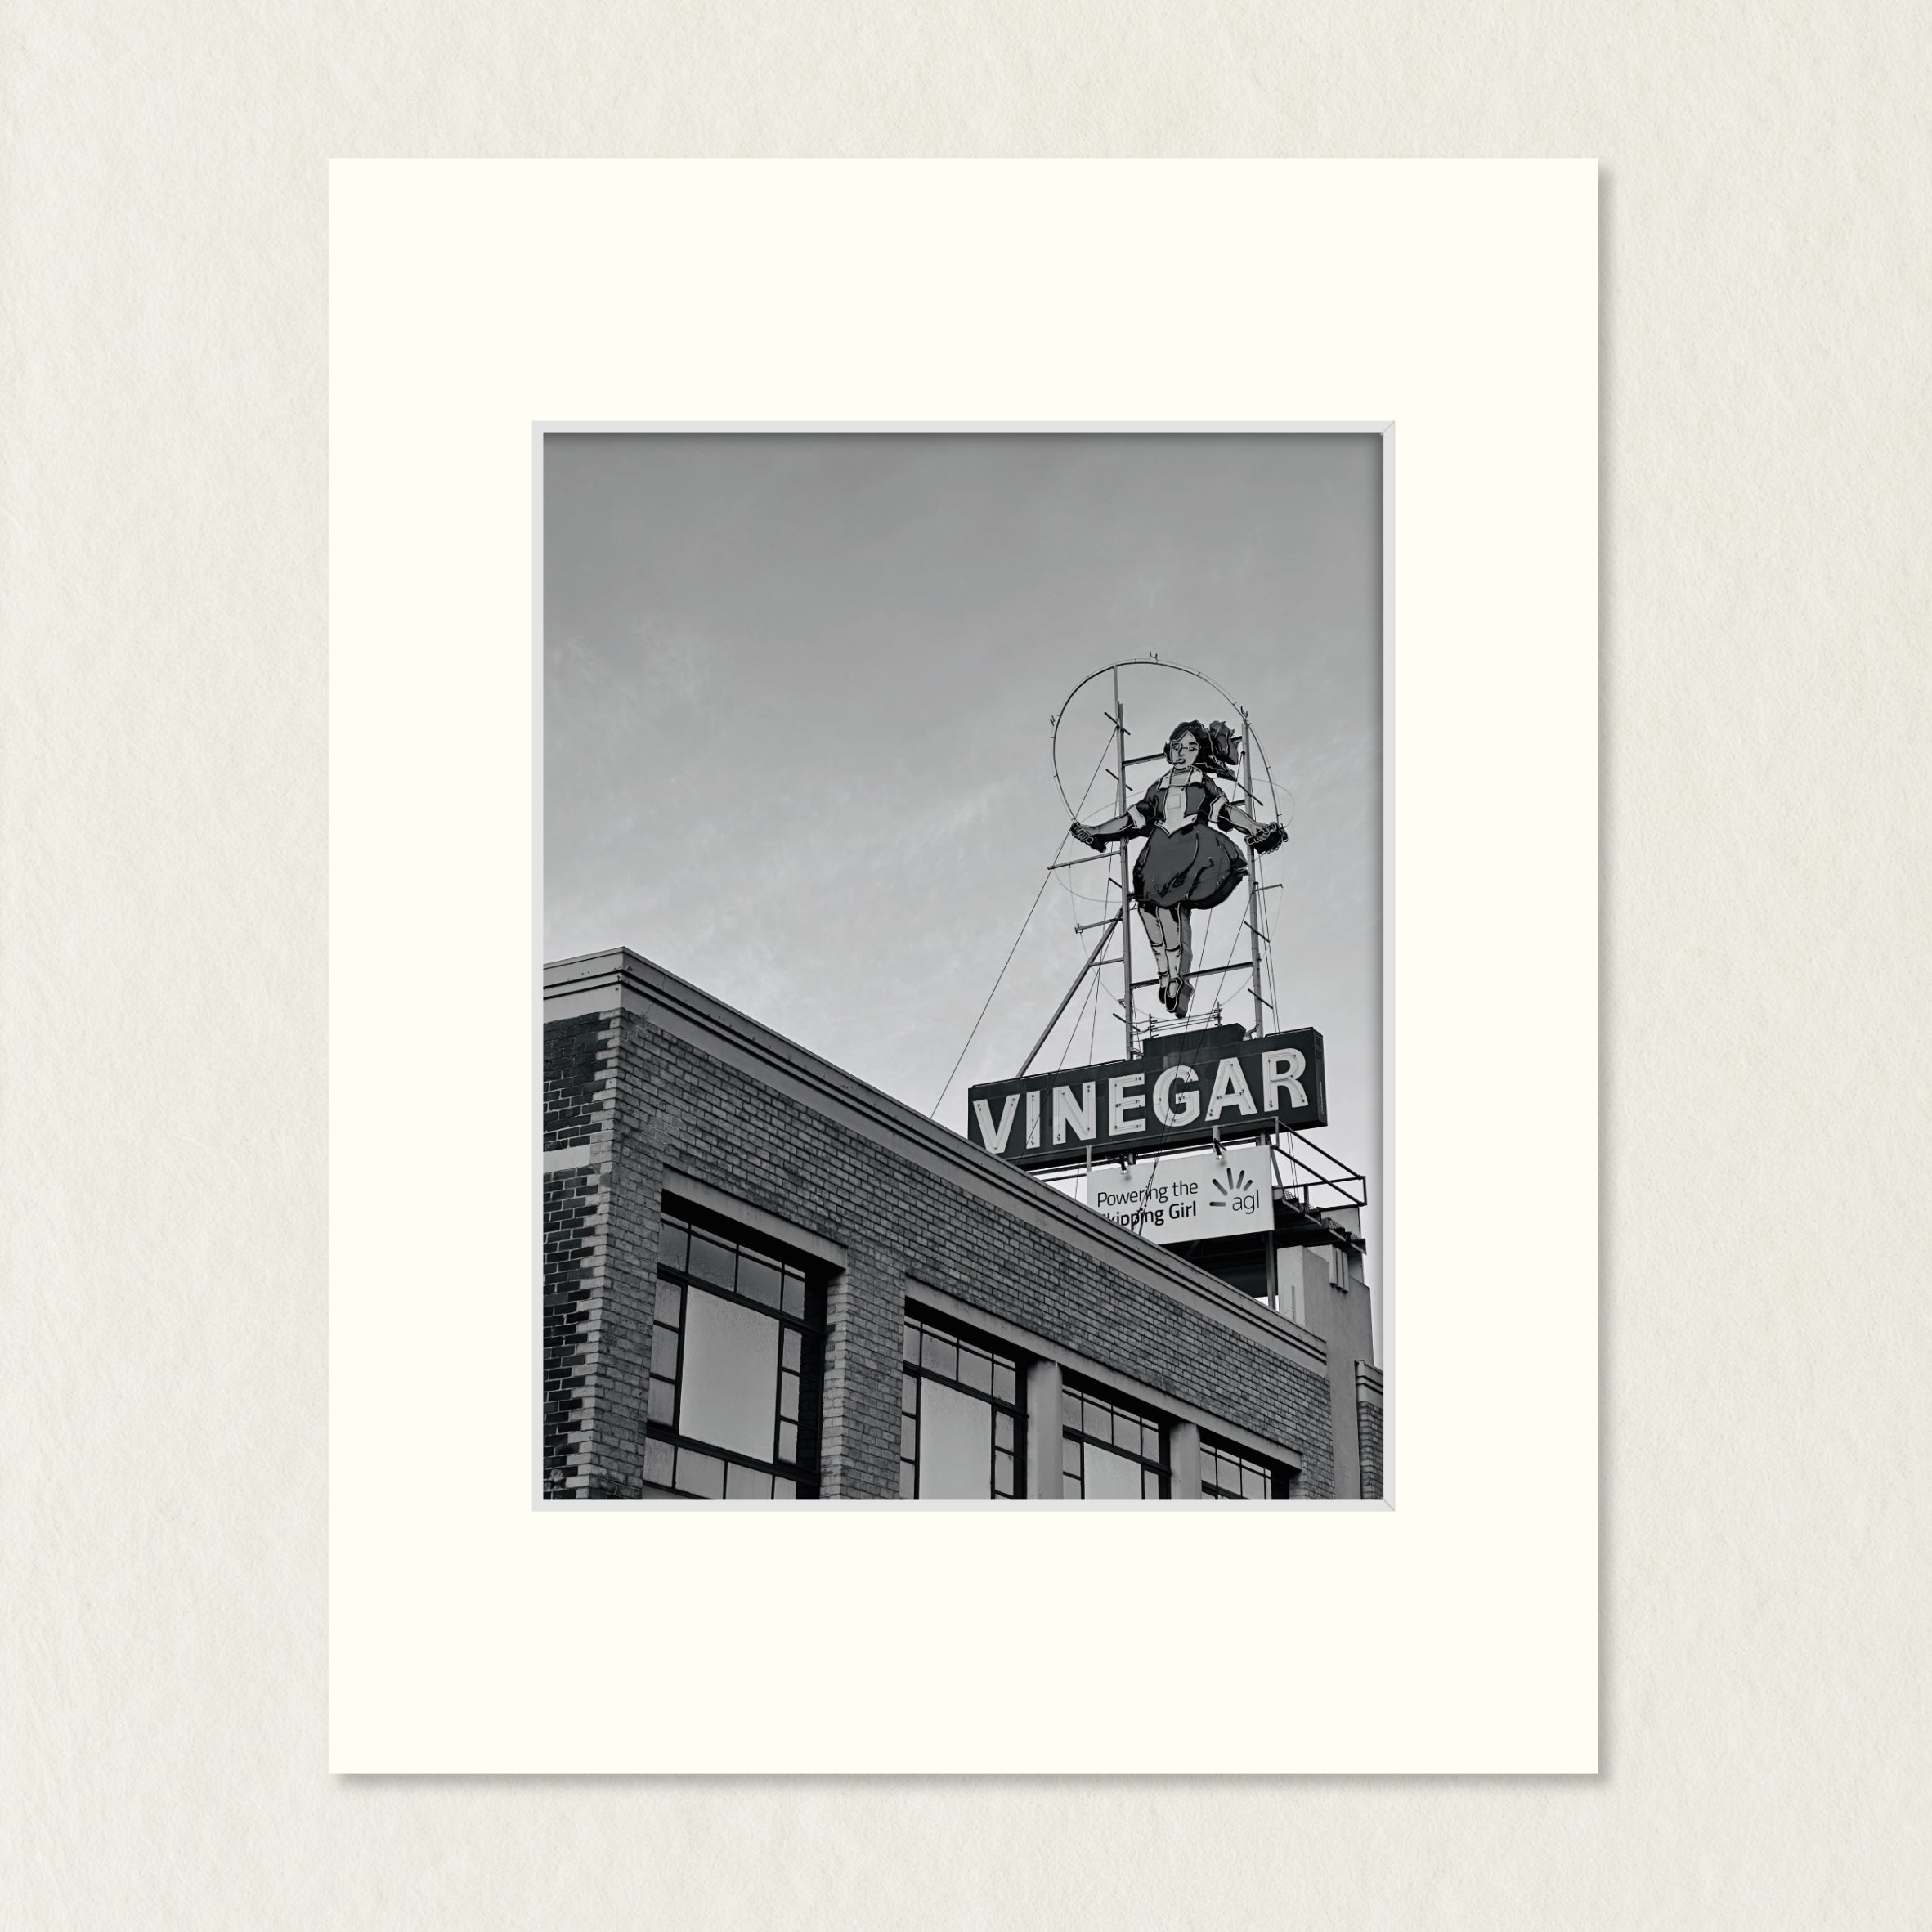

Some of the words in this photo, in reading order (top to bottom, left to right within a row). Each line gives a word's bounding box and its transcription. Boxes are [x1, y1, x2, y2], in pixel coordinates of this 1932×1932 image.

[972, 1047, 1309, 1154] VINEGAR
[1097, 1185, 1168, 1208] Powering
[1172, 1180, 1199, 1197] the
[1231, 1190, 1260, 1215] agl
[1102, 1208, 1165, 1231] kipping
[1168, 1200, 1197, 1219] Girl
